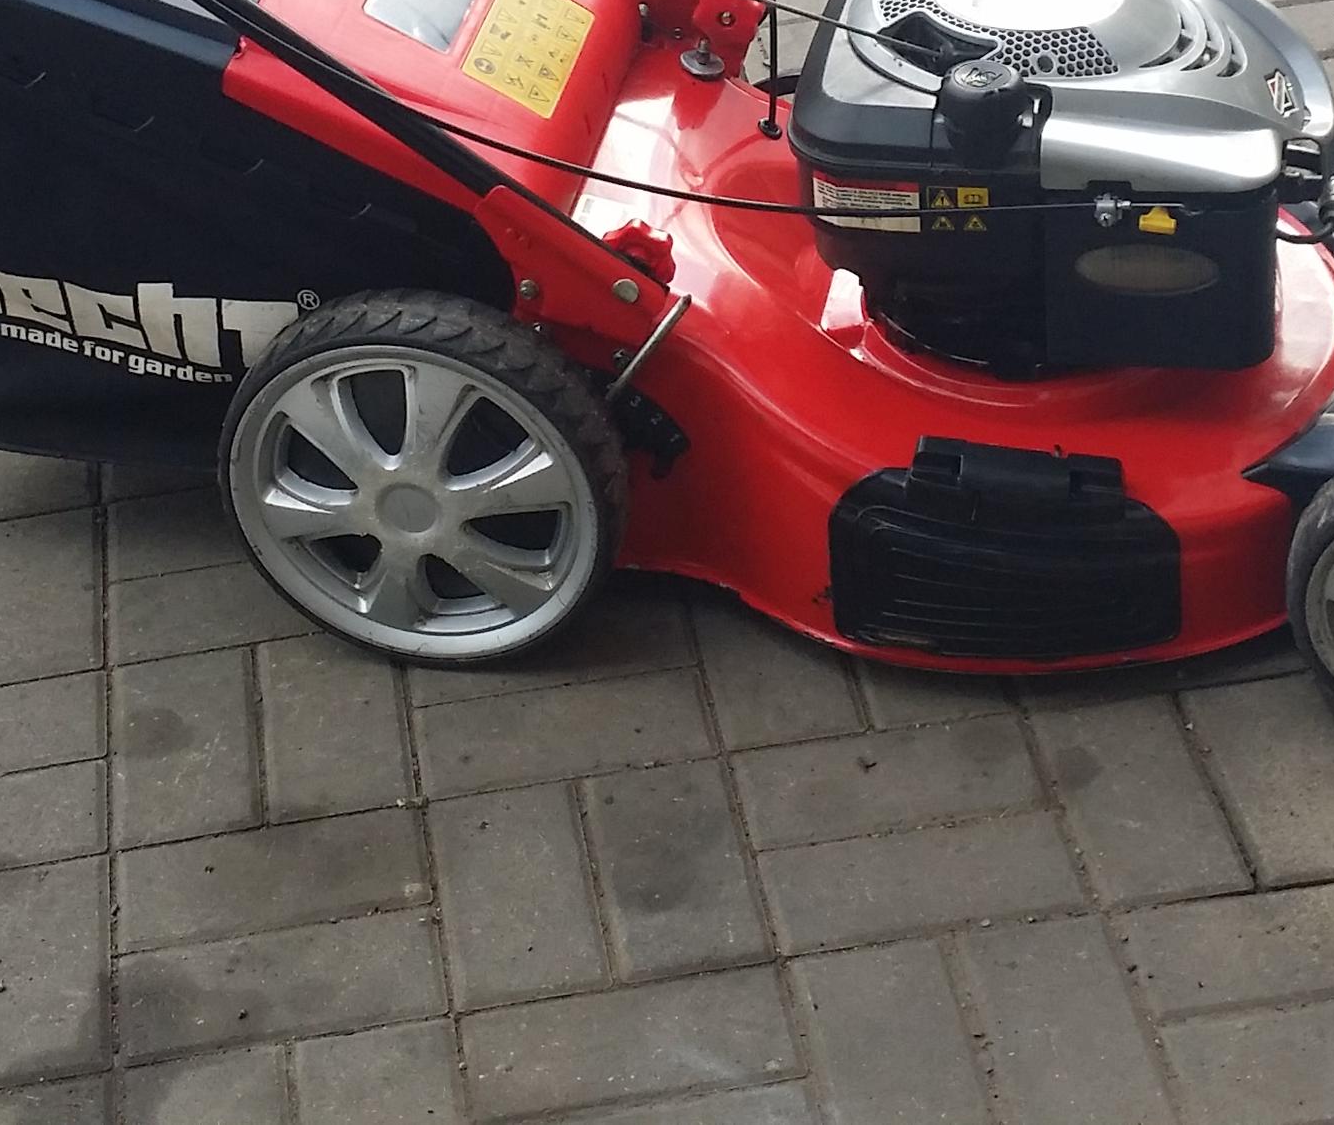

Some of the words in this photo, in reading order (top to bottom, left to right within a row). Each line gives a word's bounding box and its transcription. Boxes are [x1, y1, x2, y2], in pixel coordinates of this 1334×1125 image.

[0, 322, 79, 354] made
[81, 339, 125, 365] for
[127, 353, 233, 384] garden
